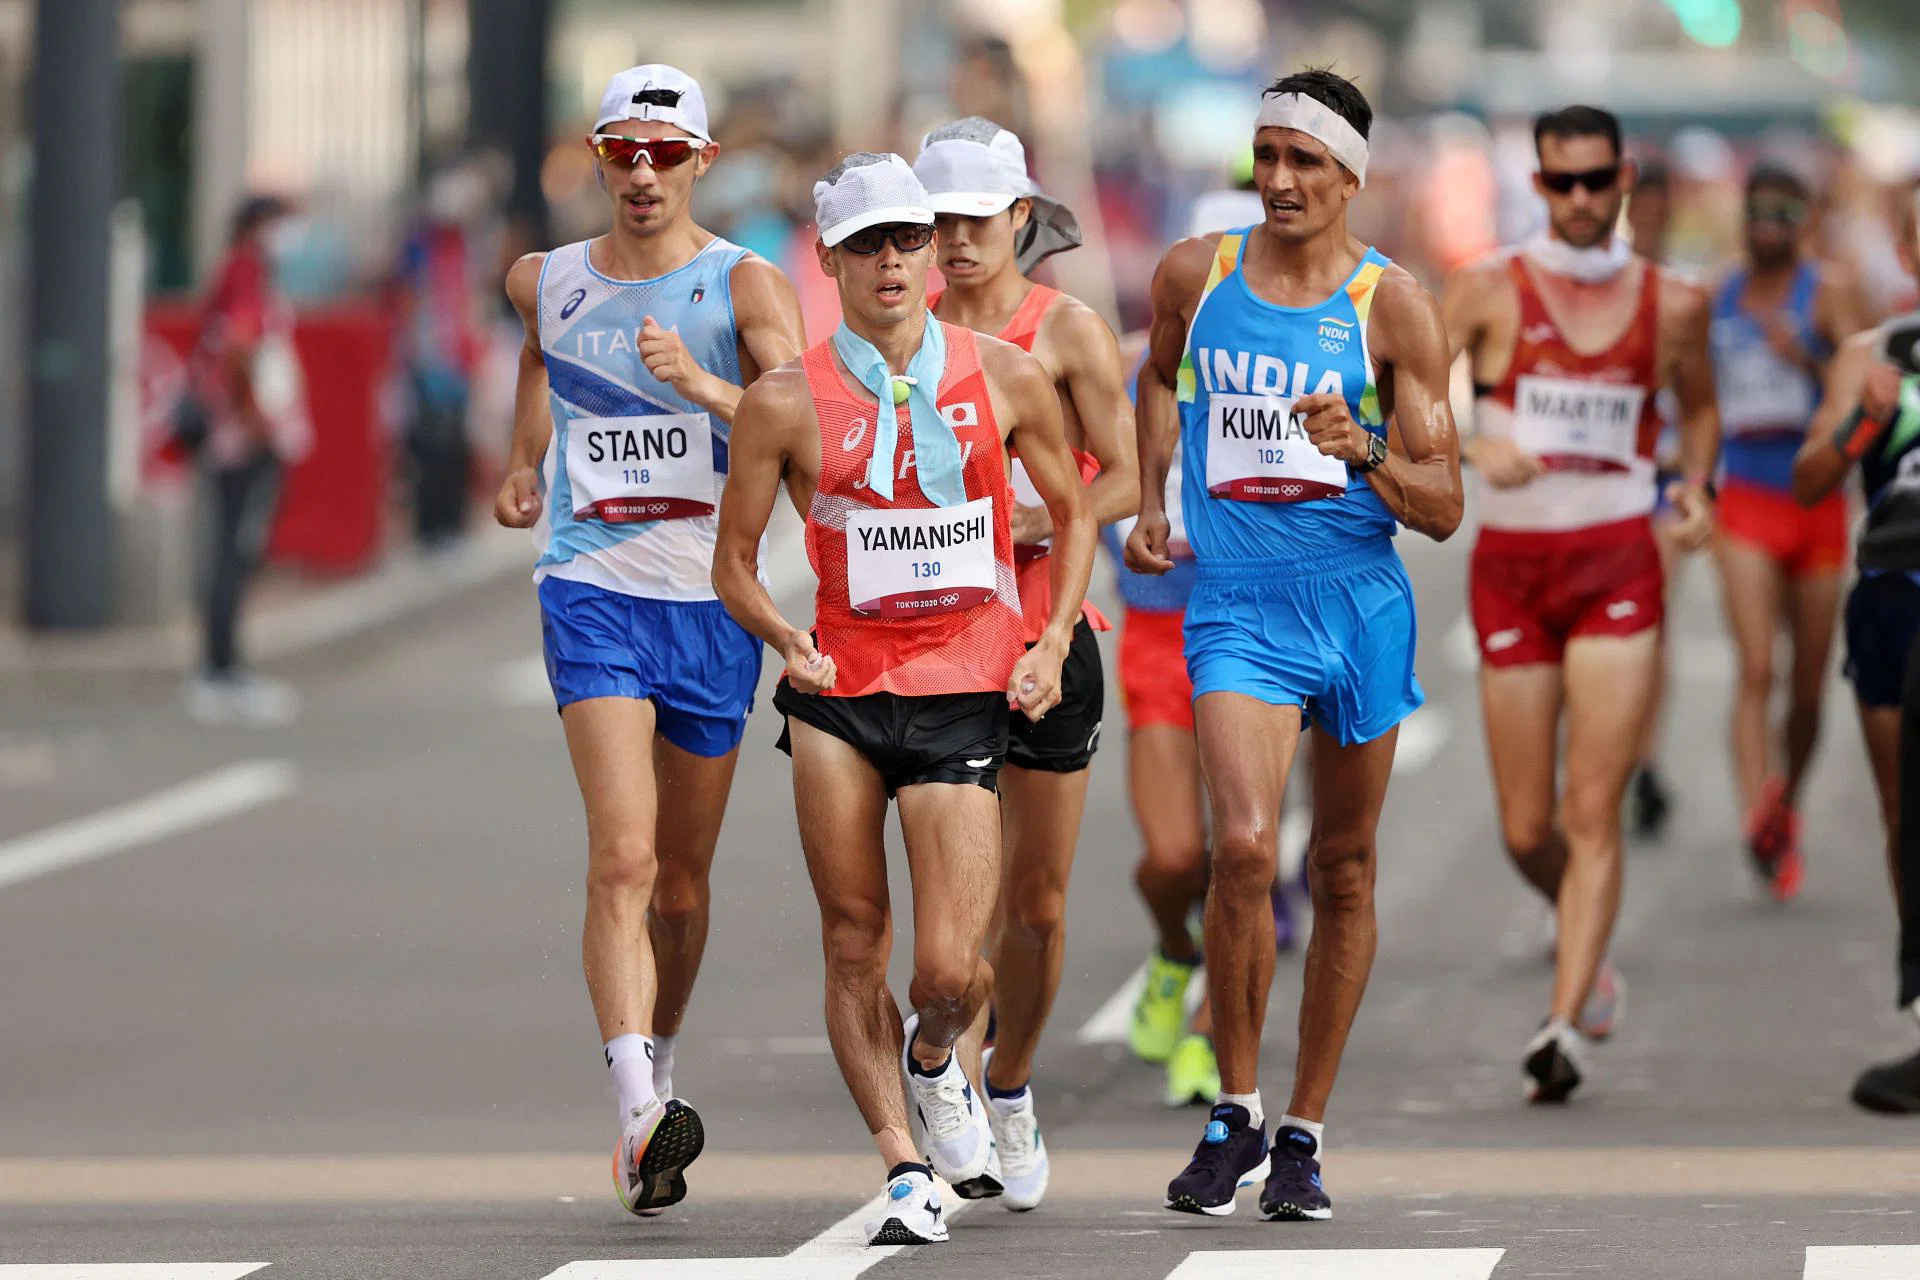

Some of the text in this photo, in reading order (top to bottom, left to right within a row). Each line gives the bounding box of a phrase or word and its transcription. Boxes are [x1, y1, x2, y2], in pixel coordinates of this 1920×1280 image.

[1318, 325, 1350, 342] INDIA
[1199, 348, 1344, 396] INDIA
[1222, 407, 1305, 441] KUMA
[588, 427, 687, 462] STANO
[1258, 449, 1285, 464] 102
[623, 469, 650, 484] 118
[1243, 485, 1280, 494] TOKYO 2020
[604, 506, 646, 514] TOKYO 2020
[858, 515, 985, 551] YAMANISHI
[911, 561, 941, 578] 130
[895, 600, 938, 609] TOKYO 2020
